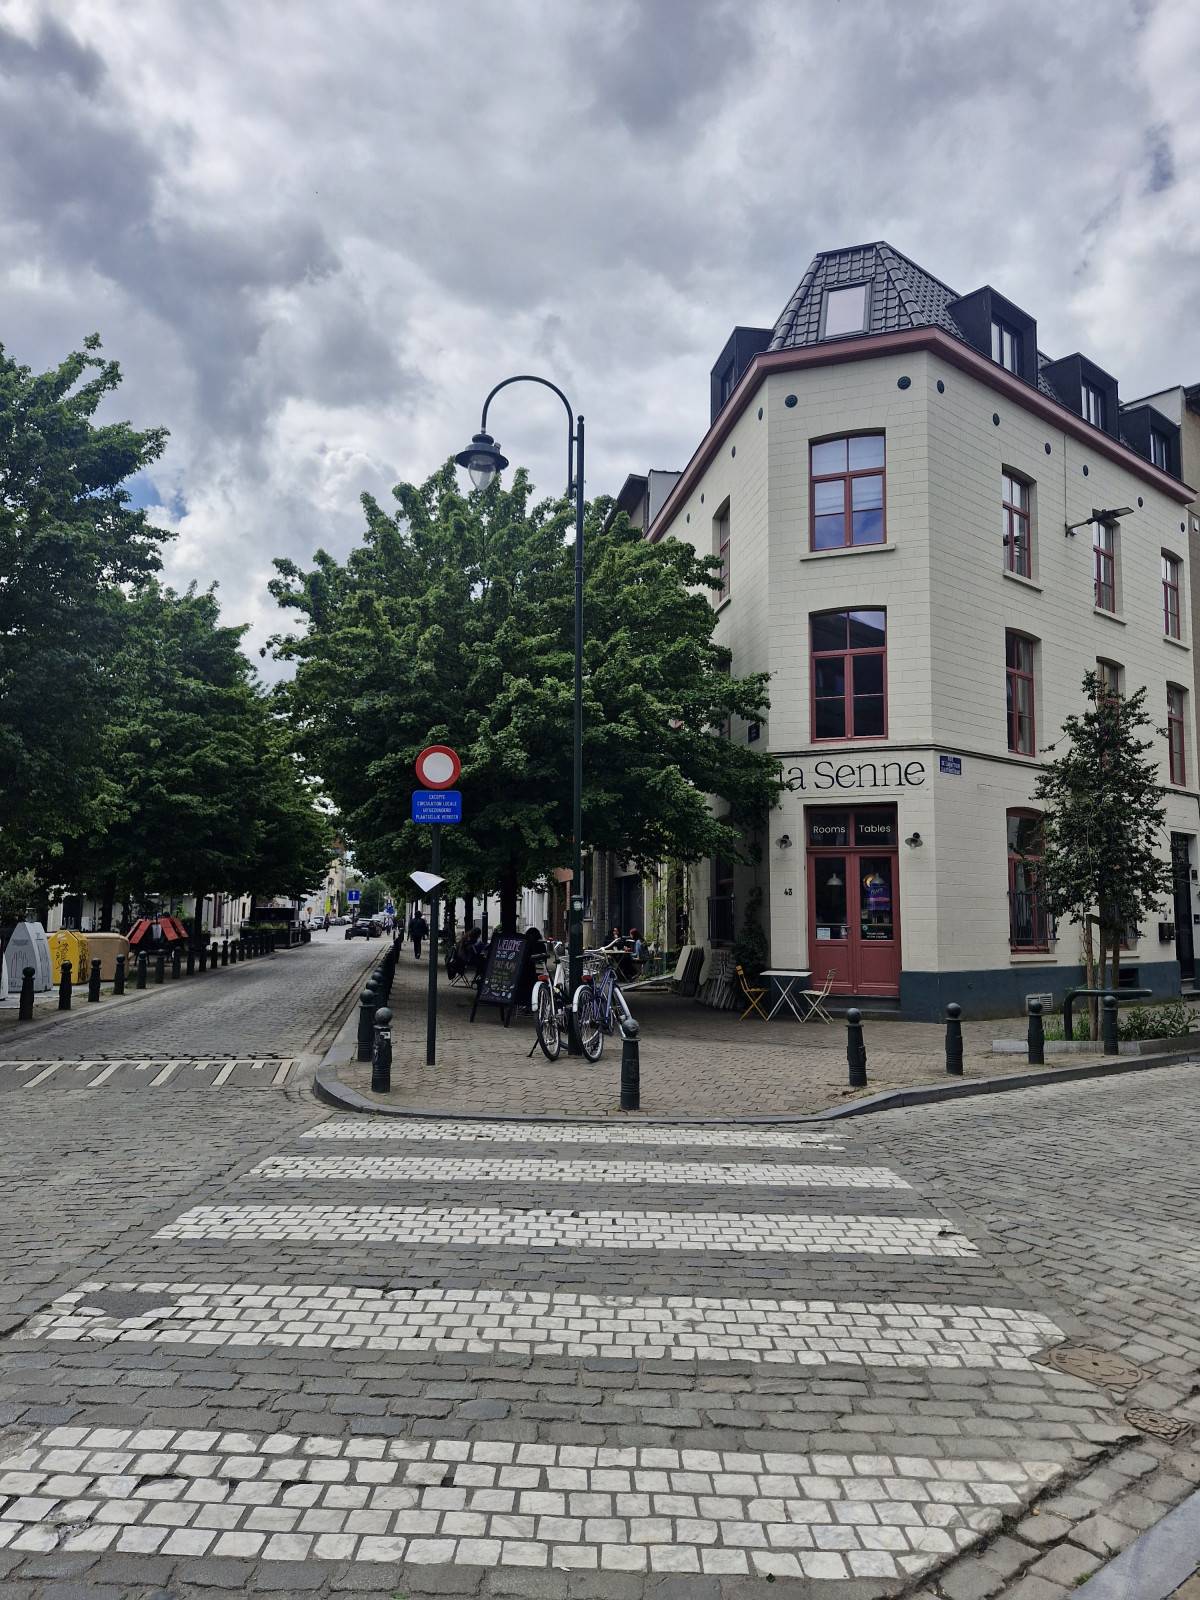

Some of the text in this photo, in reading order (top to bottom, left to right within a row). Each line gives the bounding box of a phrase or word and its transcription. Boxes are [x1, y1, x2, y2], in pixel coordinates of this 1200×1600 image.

[814, 761, 925, 789] Senne
[813, 825, 846, 834] Rooms
[859, 824, 891, 833] Tables
[783, 888, 793, 896] 43
